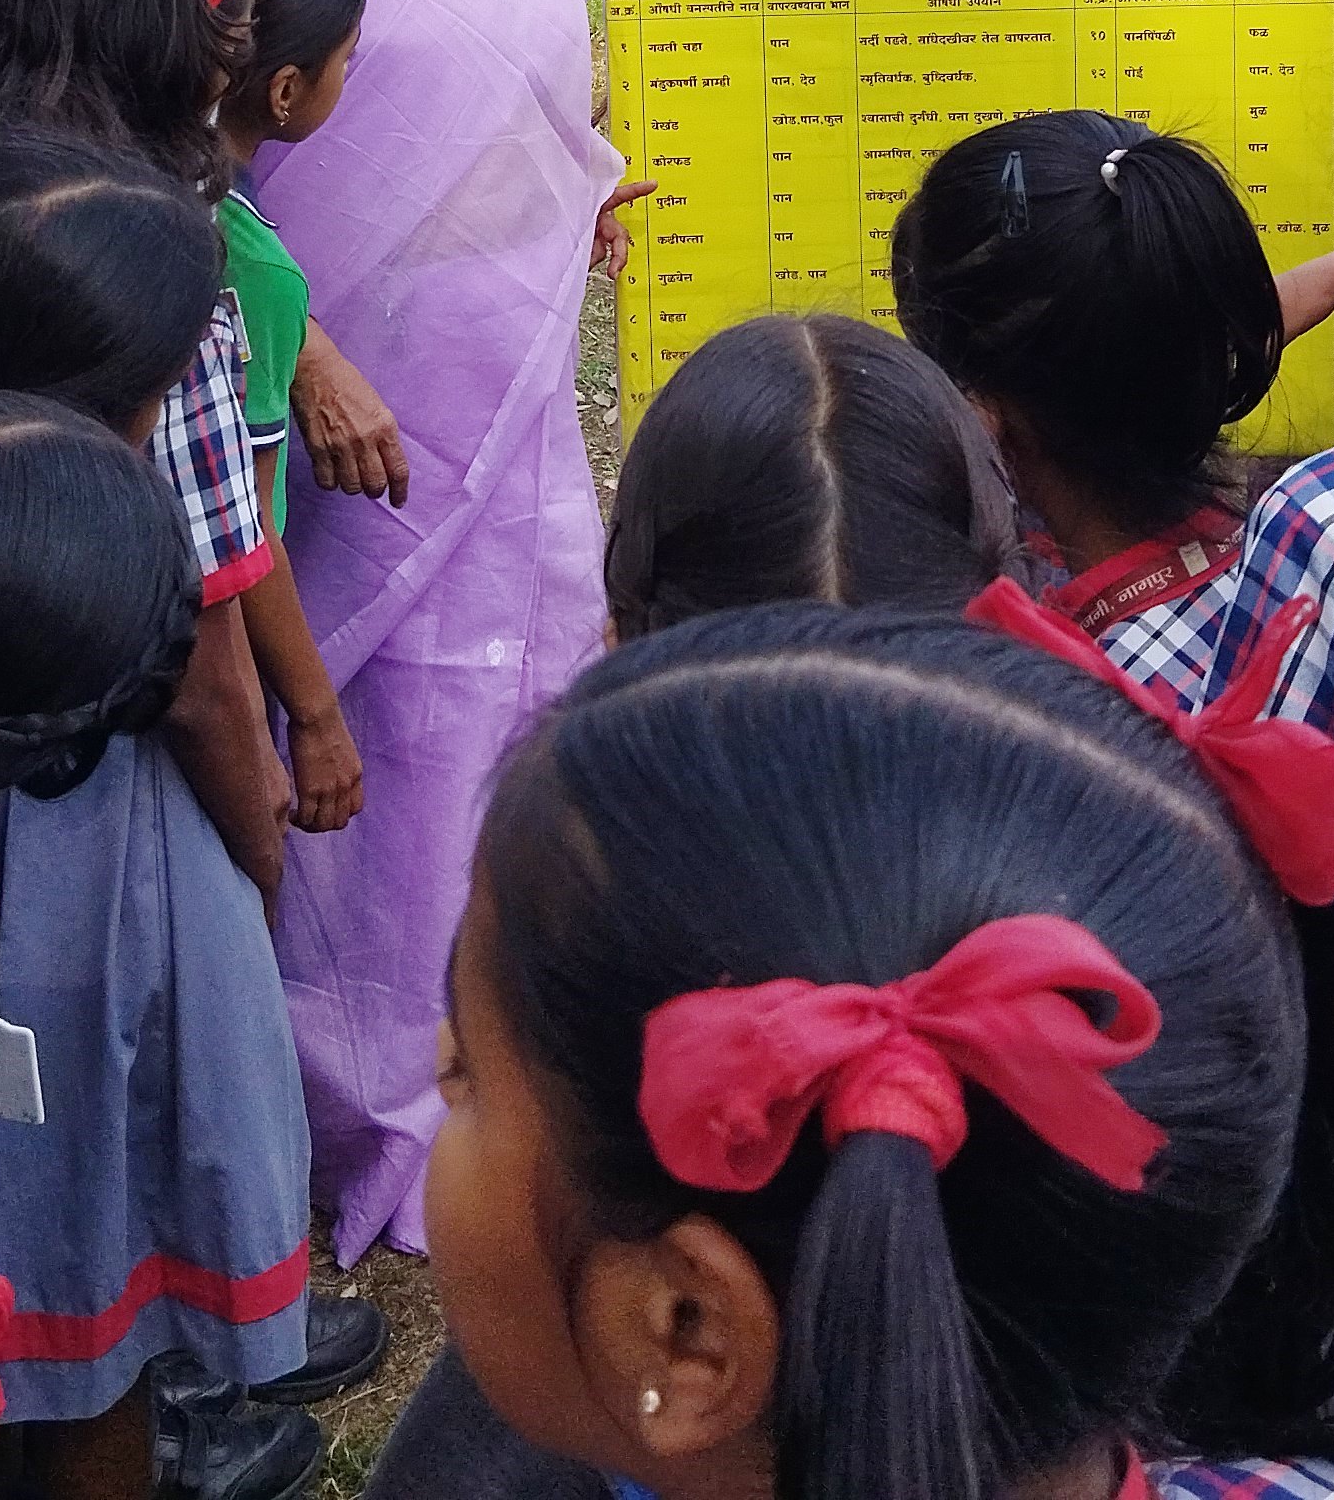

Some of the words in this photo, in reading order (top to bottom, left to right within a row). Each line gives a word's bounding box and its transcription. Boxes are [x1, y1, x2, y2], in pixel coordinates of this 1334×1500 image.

[648, 1, 682, 14] औषधी
[739, 2, 760, 12] नाव
[981, 31, 1000, 44] तेल
[1248, 27, 1269, 38] फळ
[648, 40, 678, 53] गवती
[682, 42, 703, 53] चहा
[770, 39, 790, 49] पान
[799, 73, 816, 86] देठ
[622, 80, 631, 92] २
[1249, 105, 1268, 119] मुळ
[624, 120, 632, 132] ३
[1248, 143, 1268, 152] पान
[651, 154, 692, 168] कोरफड
[772, 151, 793, 162] पान
[655, 195, 687, 210] पुदीना
[773, 193, 793, 204] पान
[774, 231, 794, 242] पान
[628, 275, 637, 285] ७
[808, 269, 827, 280] पान
[1115, 565, 1175, 603] नागपुर
